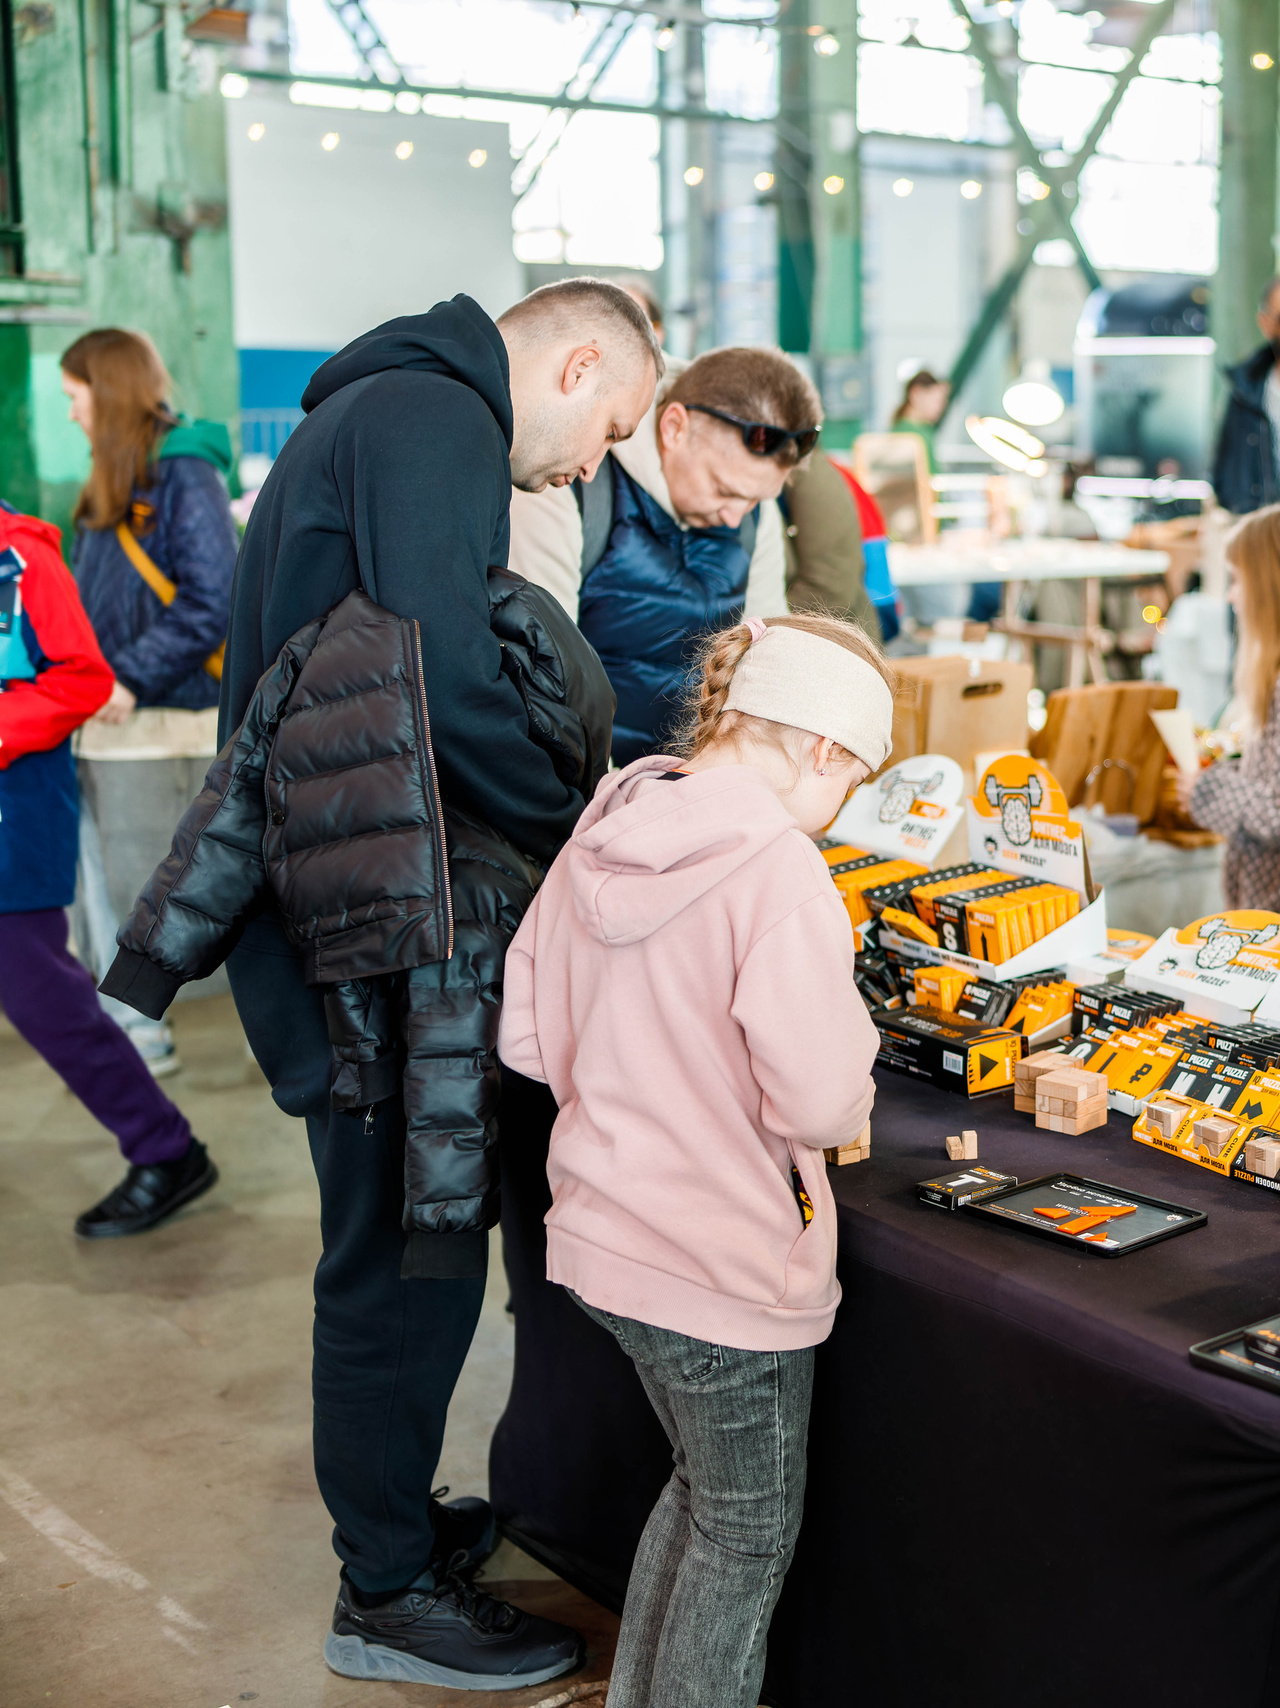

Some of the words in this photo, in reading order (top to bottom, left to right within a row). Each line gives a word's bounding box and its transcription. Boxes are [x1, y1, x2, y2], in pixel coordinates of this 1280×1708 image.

[1225, 963, 1248, 975] ДЛЯ
[1197, 974, 1225, 987] PUZZLE
[1208, 1037, 1216, 1049] IQ
[1180, 1052, 1190, 1063] IQ
[1188, 1054, 1215, 1069] PUZZLE
[1215, 1064, 1225, 1075] IQ
[1222, 1065, 1249, 1080] PUZZLE
[1252, 1075, 1261, 1085] IQ
[1153, 1138, 1163, 1147] ДЛЯ
[1163, 1142, 1178, 1152] МОЗГА
[1200, 1156, 1211, 1164] ДЛЯ
[1210, 1160, 1226, 1171] МОЗГА
[1234, 1169, 1255, 1184] PUZZLE
[1255, 1176, 1280, 1191] WOODEN
